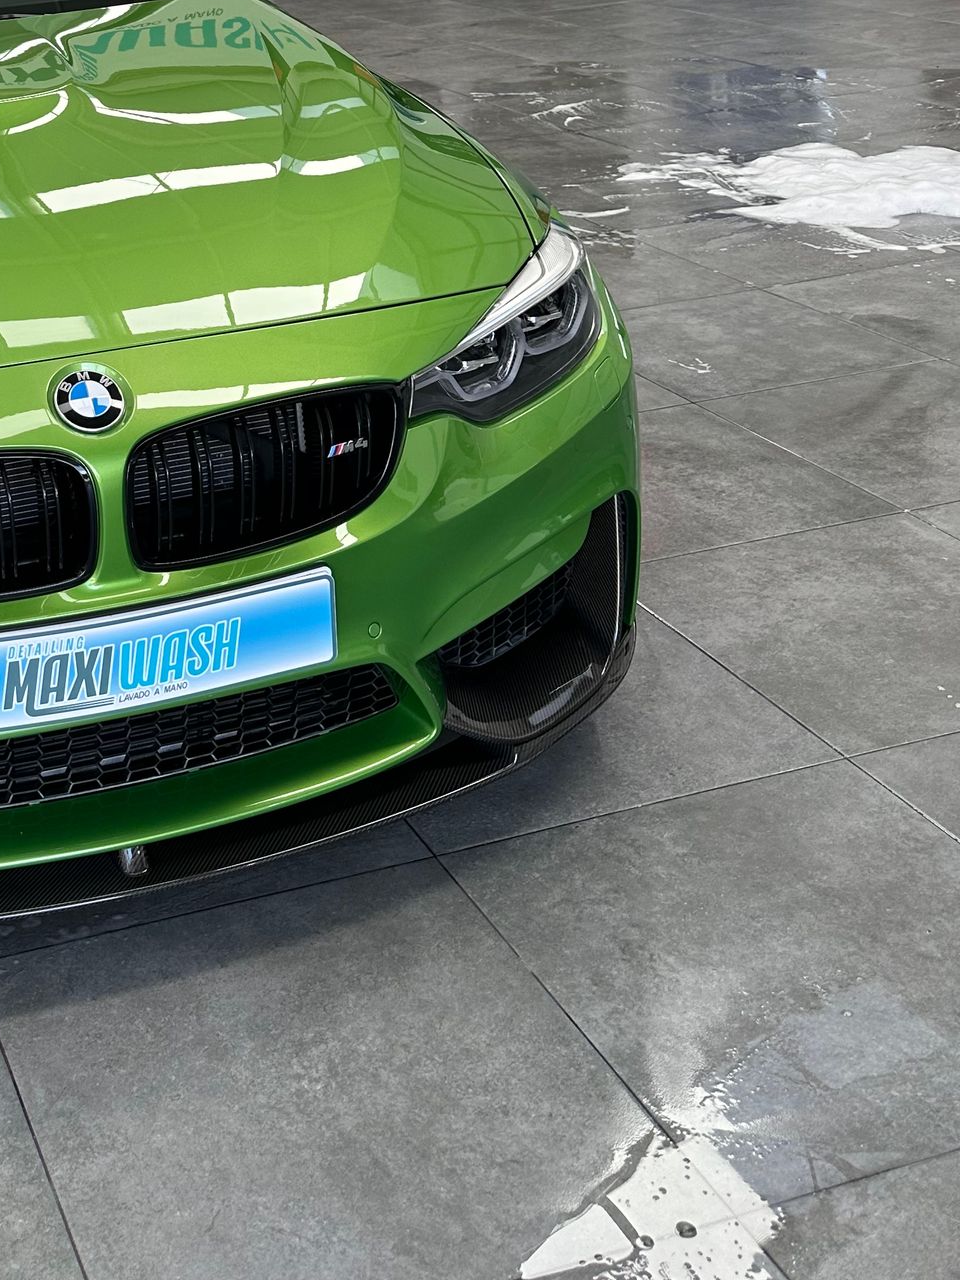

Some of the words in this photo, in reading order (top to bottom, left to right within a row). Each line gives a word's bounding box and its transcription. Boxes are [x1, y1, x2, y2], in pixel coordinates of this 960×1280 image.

[58, 370, 115, 394] BMW
[8, 635, 85, 660] DETAILING
[3, 644, 114, 717] MAXI
[118, 617, 241, 691] WASH
[118, 689, 150, 704] LAVADO
[164, 682, 188, 695] MANO
